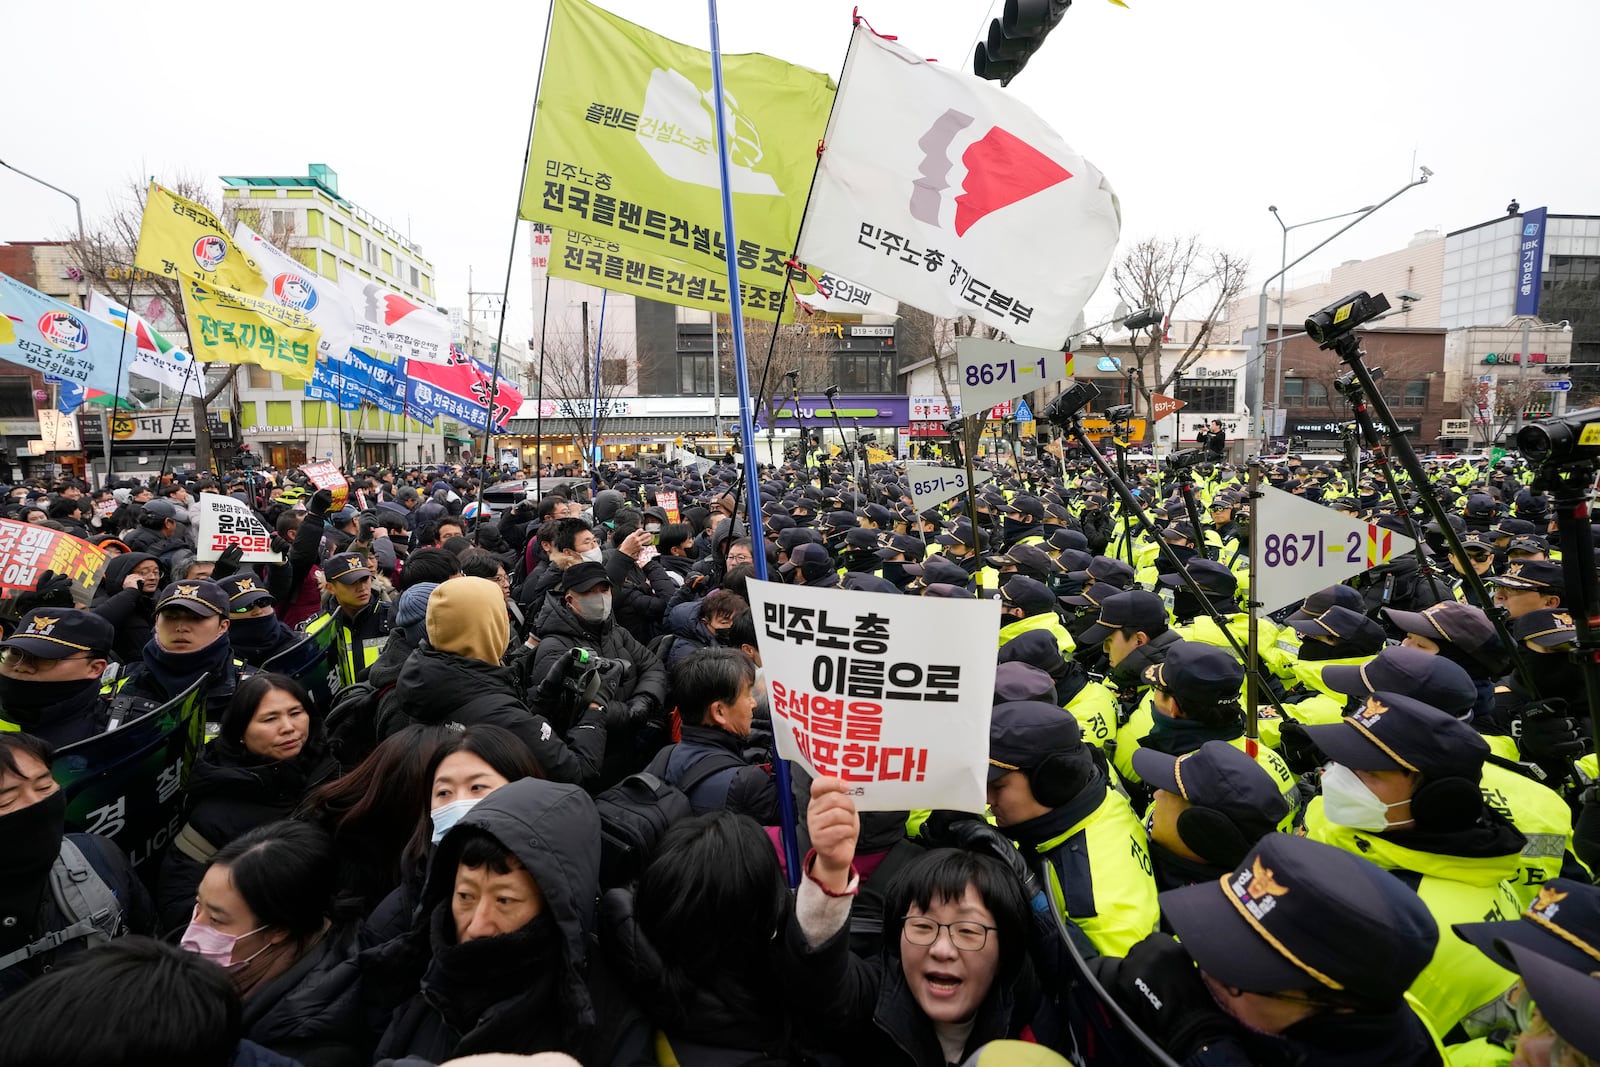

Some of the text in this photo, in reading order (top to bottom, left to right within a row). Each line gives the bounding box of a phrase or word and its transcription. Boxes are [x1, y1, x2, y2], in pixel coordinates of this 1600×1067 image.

[546, 159, 612, 191] 민주노총
[1522, 239, 1539, 251] IBK
[858, 222, 1034, 325] 민주노총 경기도본부
[1520, 250, 1535, 296] 기업은행
[965, 357, 1046, 387] 86기-1
[793, 407, 814, 419] CU
[914, 474, 965, 496] 85기-3
[1264, 530, 1362, 568] 86기-2
[764, 601, 890, 654] 민주노총
[812, 654, 961, 703] 이름으로
[772, 680, 883, 742] 윤석열을
[792, 726, 928, 782] 체포한다!
[1134, 977, 1163, 1010] POLICE
